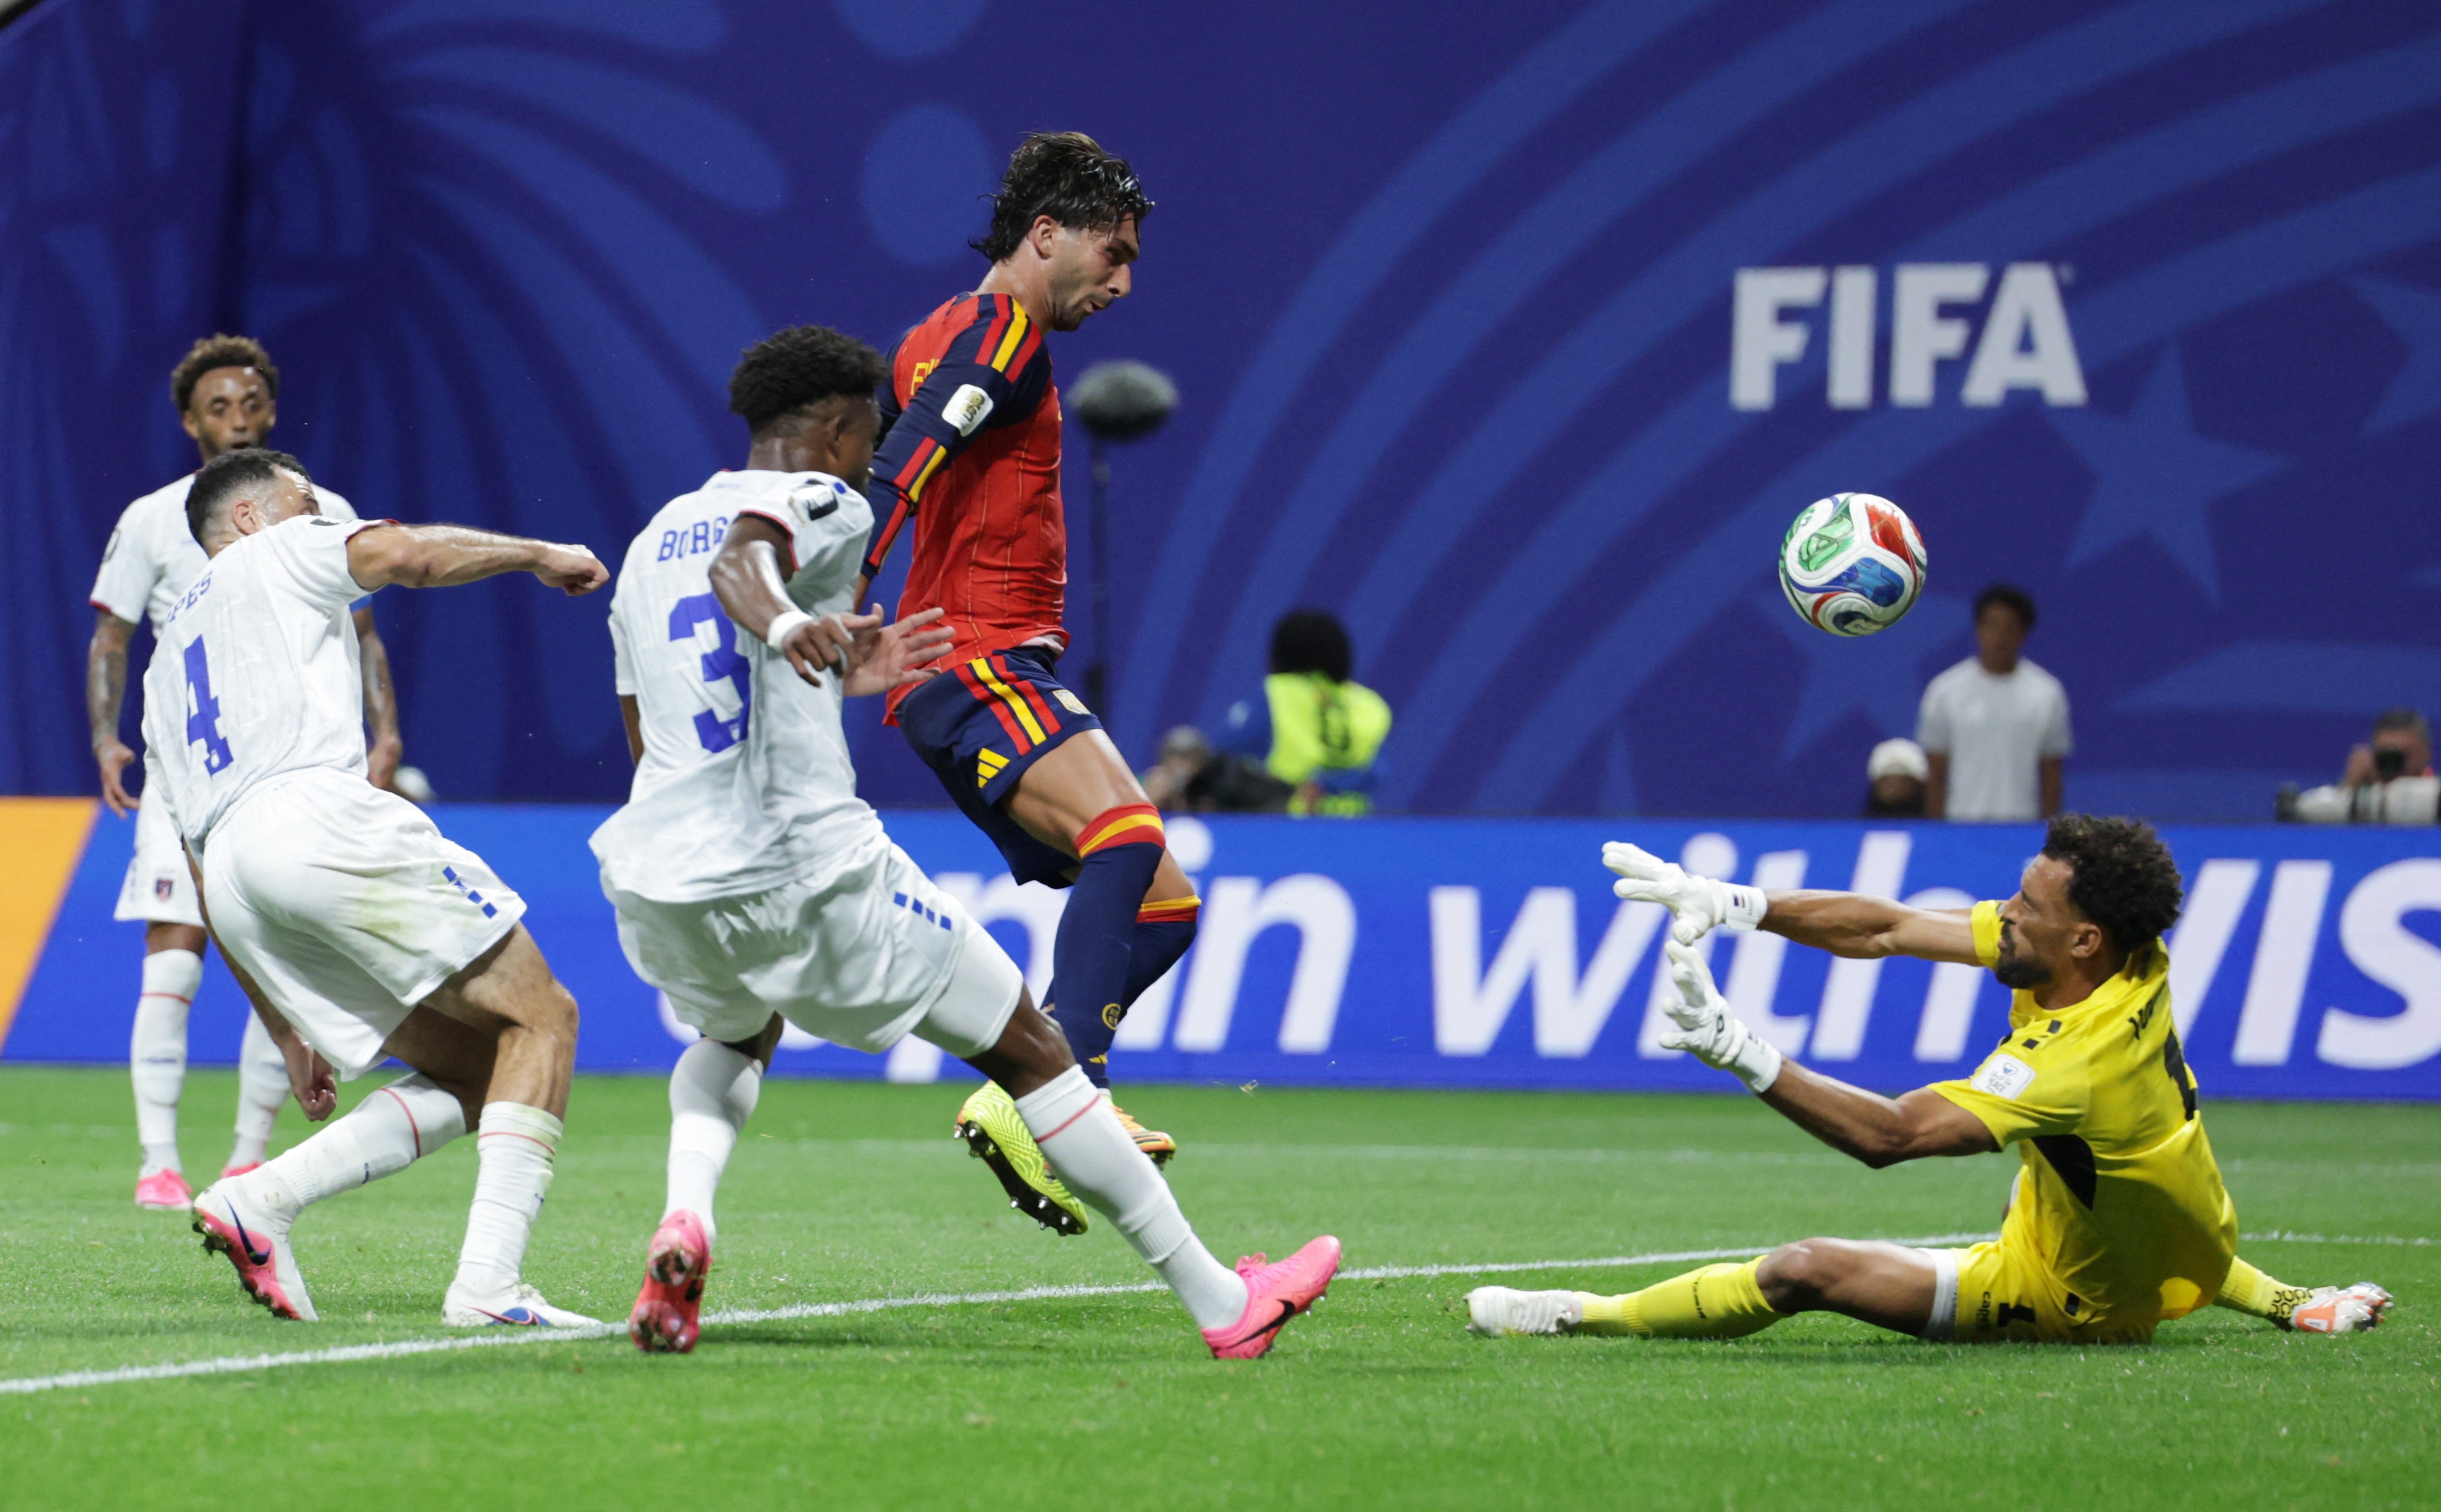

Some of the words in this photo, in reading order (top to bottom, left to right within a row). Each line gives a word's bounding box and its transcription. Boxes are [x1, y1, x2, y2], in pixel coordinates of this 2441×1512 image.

[1729, 261, 2088, 411] FIFA
[160, 570, 213, 637] PES
[669, 590, 751, 754] 3
[184, 633, 234, 772] 4
[657, 816, 1356, 1084] pin
[1429, 831, 1984, 1064] with
